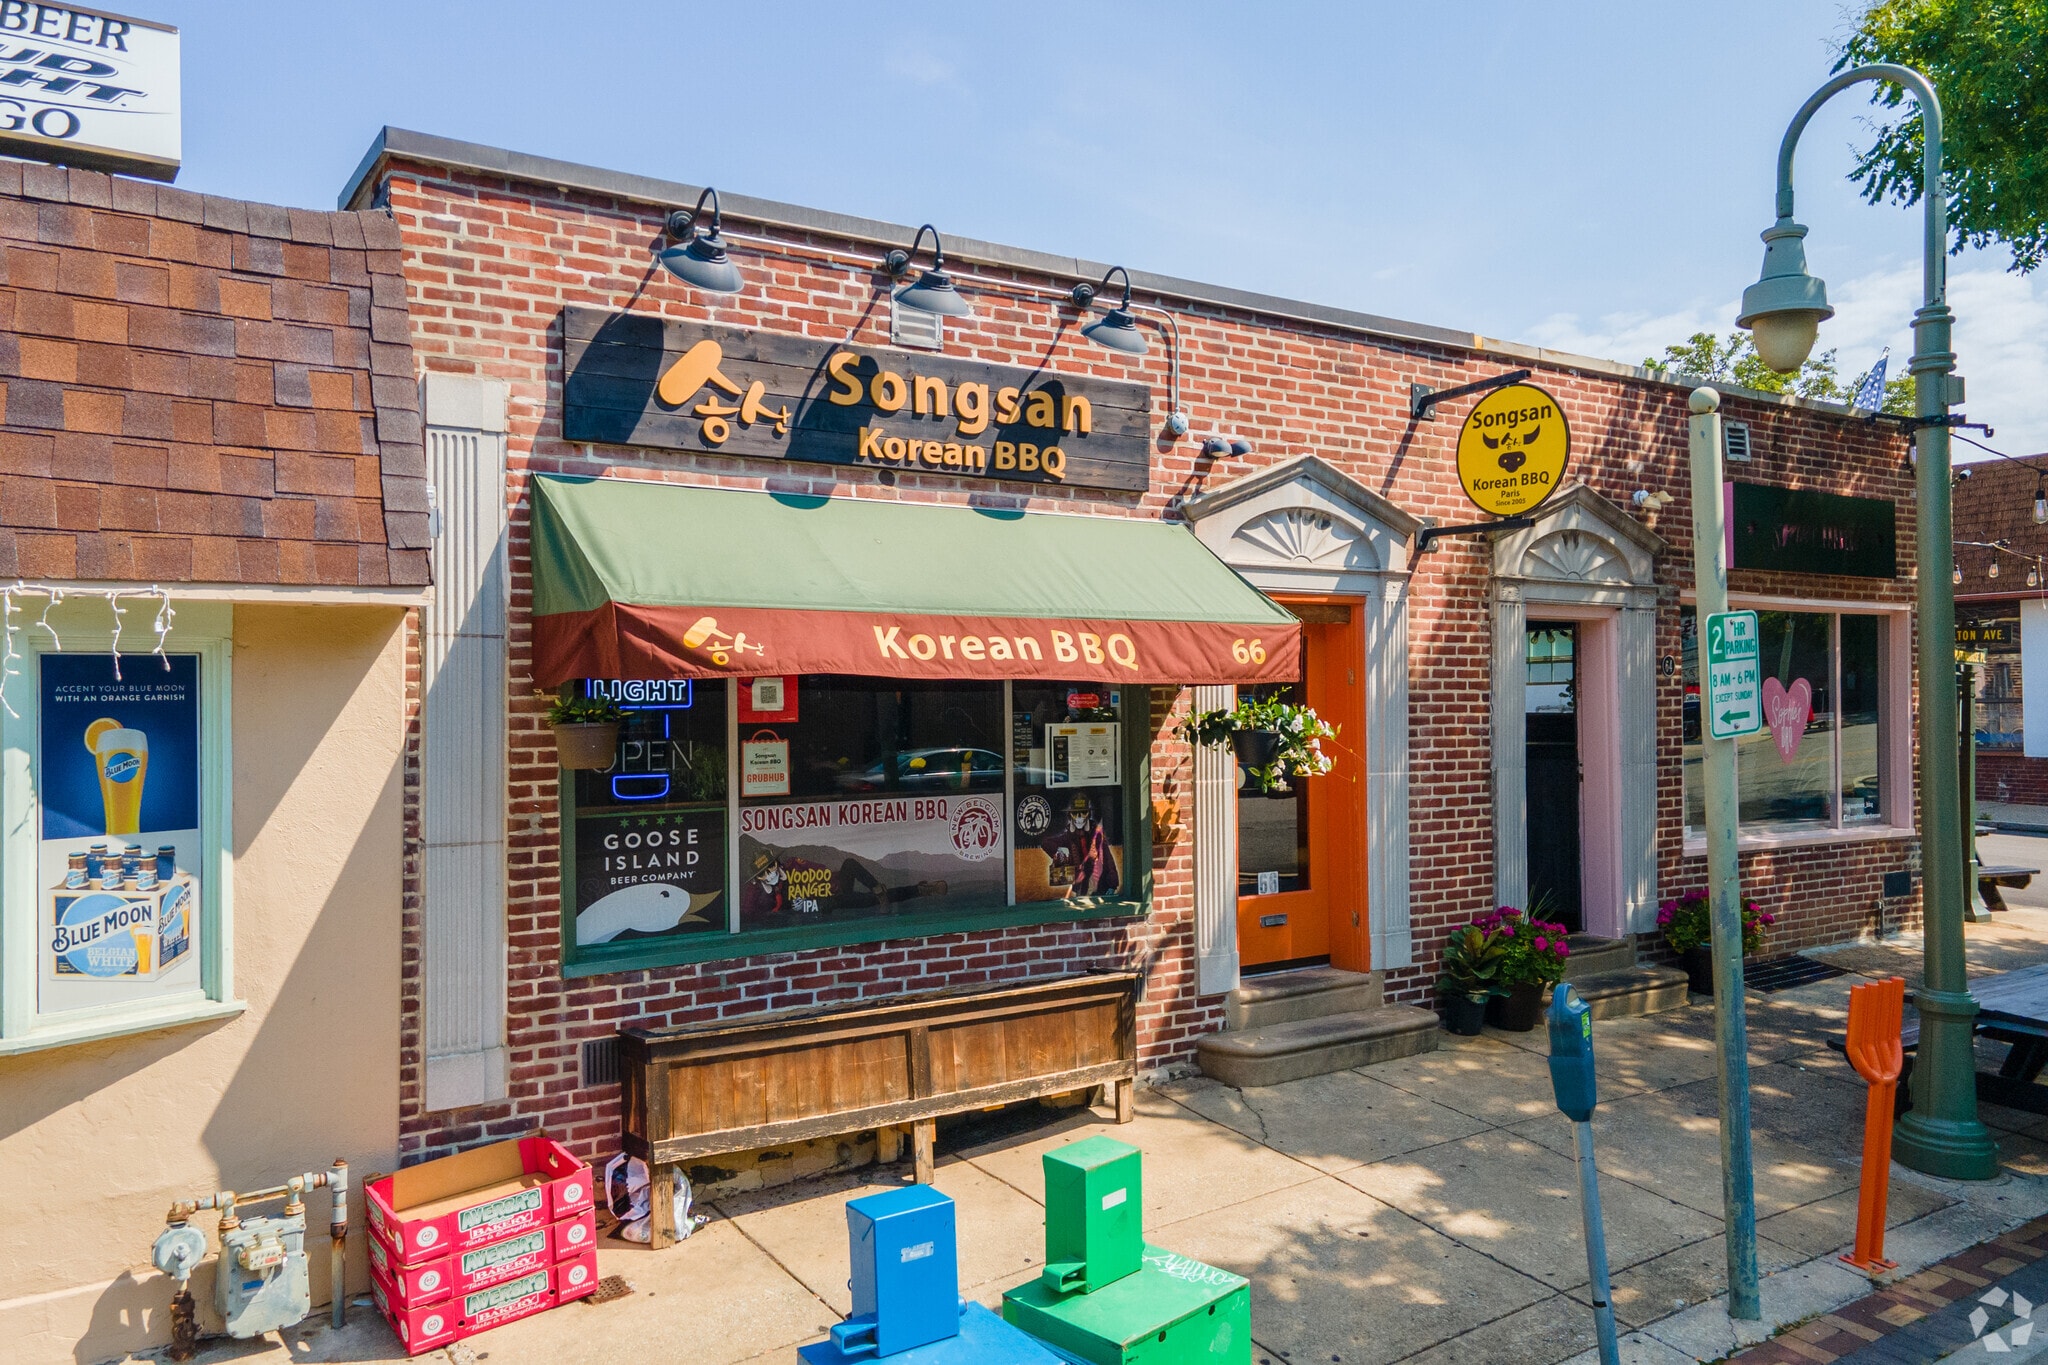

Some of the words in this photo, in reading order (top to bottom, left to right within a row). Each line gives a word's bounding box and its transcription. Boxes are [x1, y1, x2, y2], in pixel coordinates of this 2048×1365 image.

[0, 1, 130, 52] BEER
[658, 339, 792, 443] 송산
[828, 351, 1093, 434] Songsan
[1472, 404, 1552, 429] Songsan
[858, 426, 986, 468] Korean
[995, 440, 1067, 479] BBQ
[1473, 477, 1517, 491] Korean
[1521, 471, 1549, 486] BBQ
[1501, 489, 1520, 498] Paris
[683, 616, 764, 666] 송산
[1712, 625, 1723, 655] 2
[1733, 621, 1746, 636] HR
[1955, 630, 1976, 641] TON
[1984, 629, 2005, 640] AVE.
[873, 625, 1043, 661] Korean
[1050, 629, 1139, 671] BBQ
[1232, 638, 1266, 665] 66
[1725, 638, 1755, 655] PARKING
[55, 685, 95, 693] ACCENT
[129, 684, 152, 692] BLUE
[156, 684, 185, 692] MOON
[1713, 675, 1718, 687] 8
[1720, 673, 1730, 686] AM
[1737, 673, 1743, 685] 6
[1744, 670, 1755, 683] PM
[101, 694, 141, 702] ORANGE
[594, 679, 686, 701] LIGHT
[1715, 692, 1733, 703] EXCEPT
[1735, 690, 1753, 700] SUNDAY
[746, 773, 785, 783] GRUBHUB
[741, 804, 831, 832] SONGSAN
[838, 800, 908, 826] KOREAN
[914, 798, 949, 821] BBQ
[951, 807, 963, 830] NEW
[966, 800, 999, 828] BELGIUM
[604, 828, 699, 850] GOOSE
[605, 850, 700, 872] ISLAND
[610, 875, 638, 885] BEER
[641, 871, 694, 882] COMPANY
[786, 867, 832, 884] VOODOO
[788, 882, 832, 900] RANGER
[803, 899, 818, 913] IPA
[51, 921, 100, 953] BLUE
[104, 905, 152, 934] MOON
[88, 947, 136, 957] BELGIAN
[88, 957, 136, 967] WHITE
[472, 1212, 530, 1238] BAKERY
[475, 1254, 533, 1280] BAKERY
[478, 1295, 536, 1322] BAKERY
